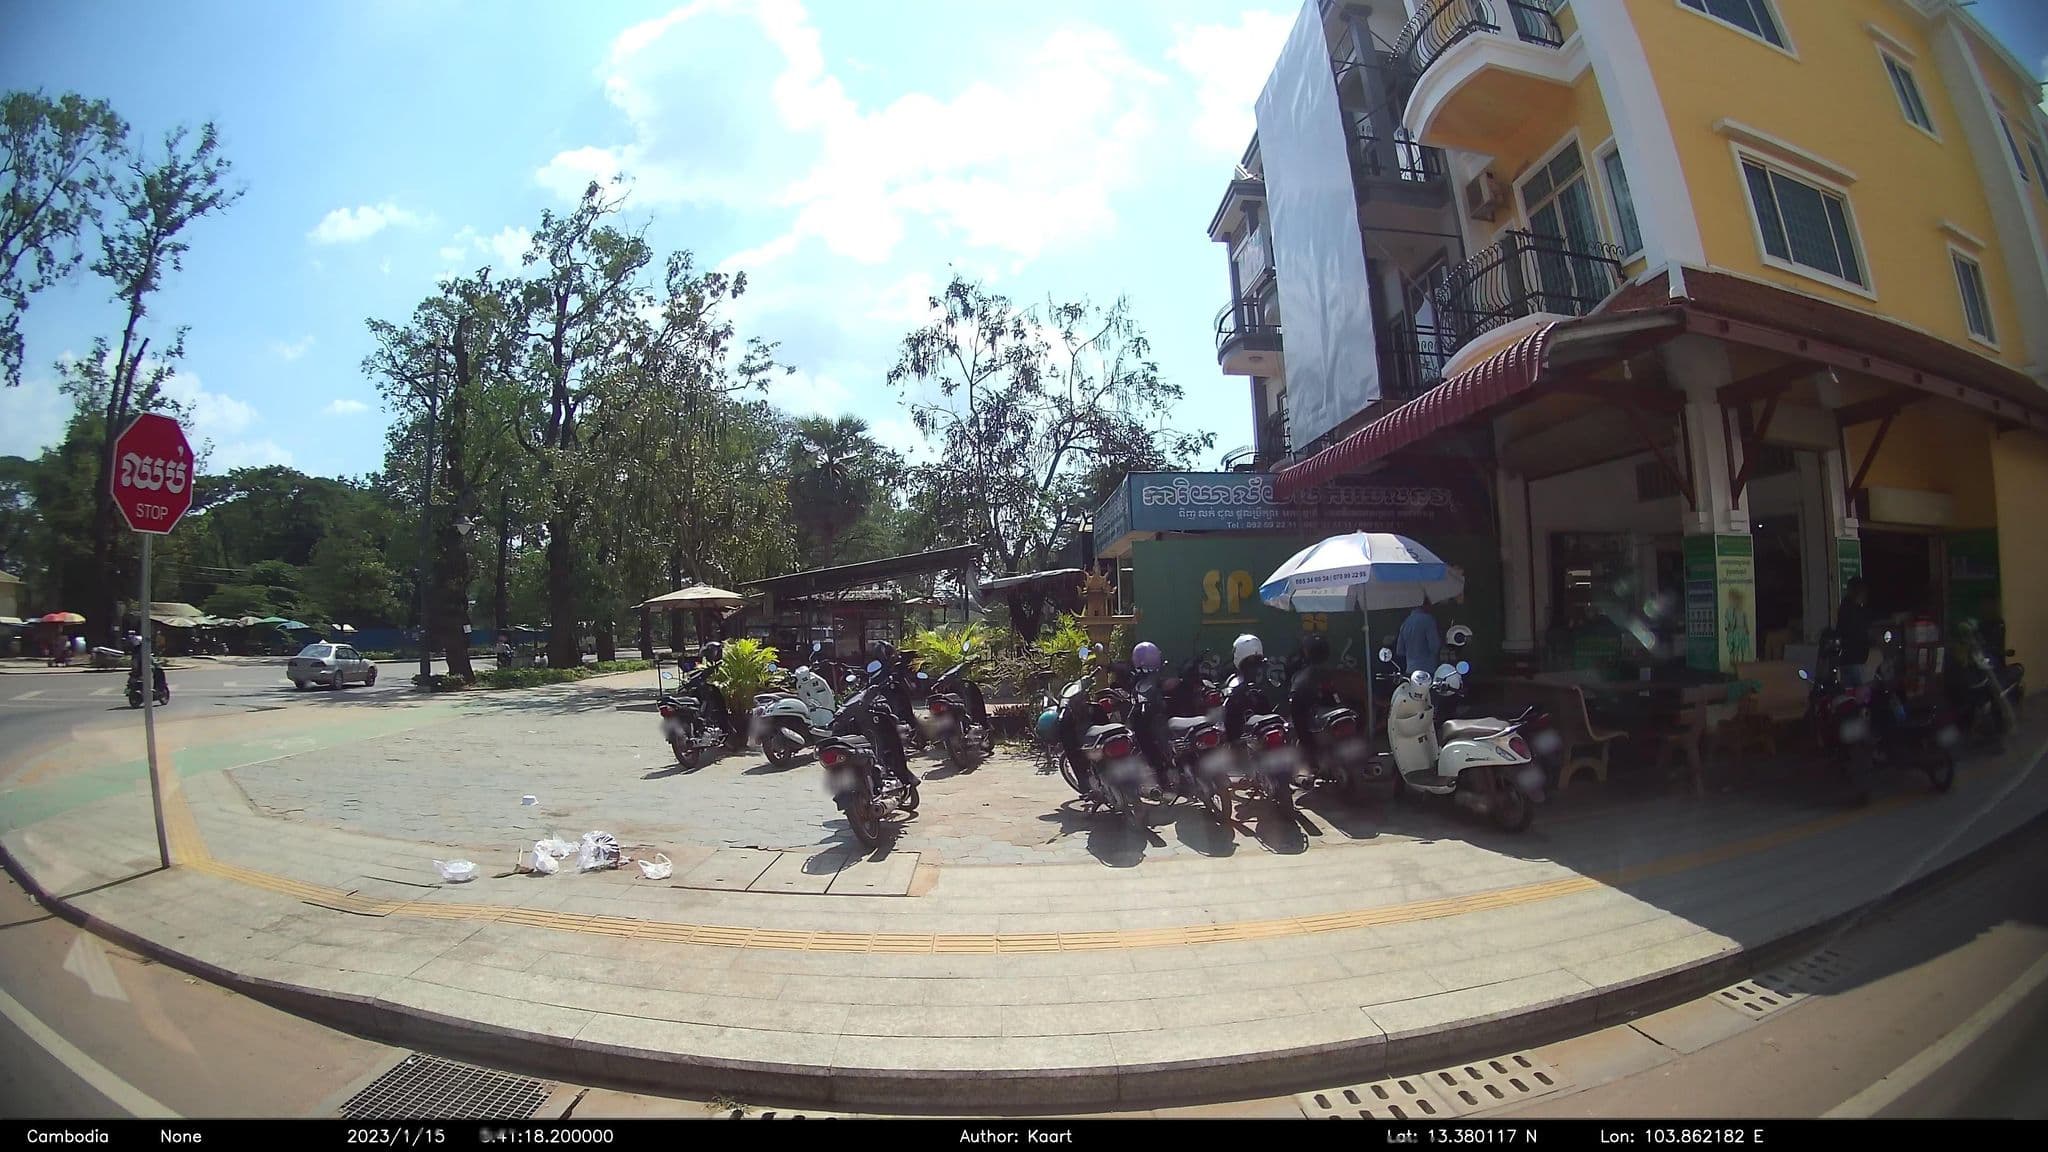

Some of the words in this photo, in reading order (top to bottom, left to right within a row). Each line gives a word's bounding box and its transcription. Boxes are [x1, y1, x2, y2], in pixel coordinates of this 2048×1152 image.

[121, 445, 187, 494] ឈប់
[136, 503, 169, 520] STOP
[1203, 570, 1253, 614] SP
